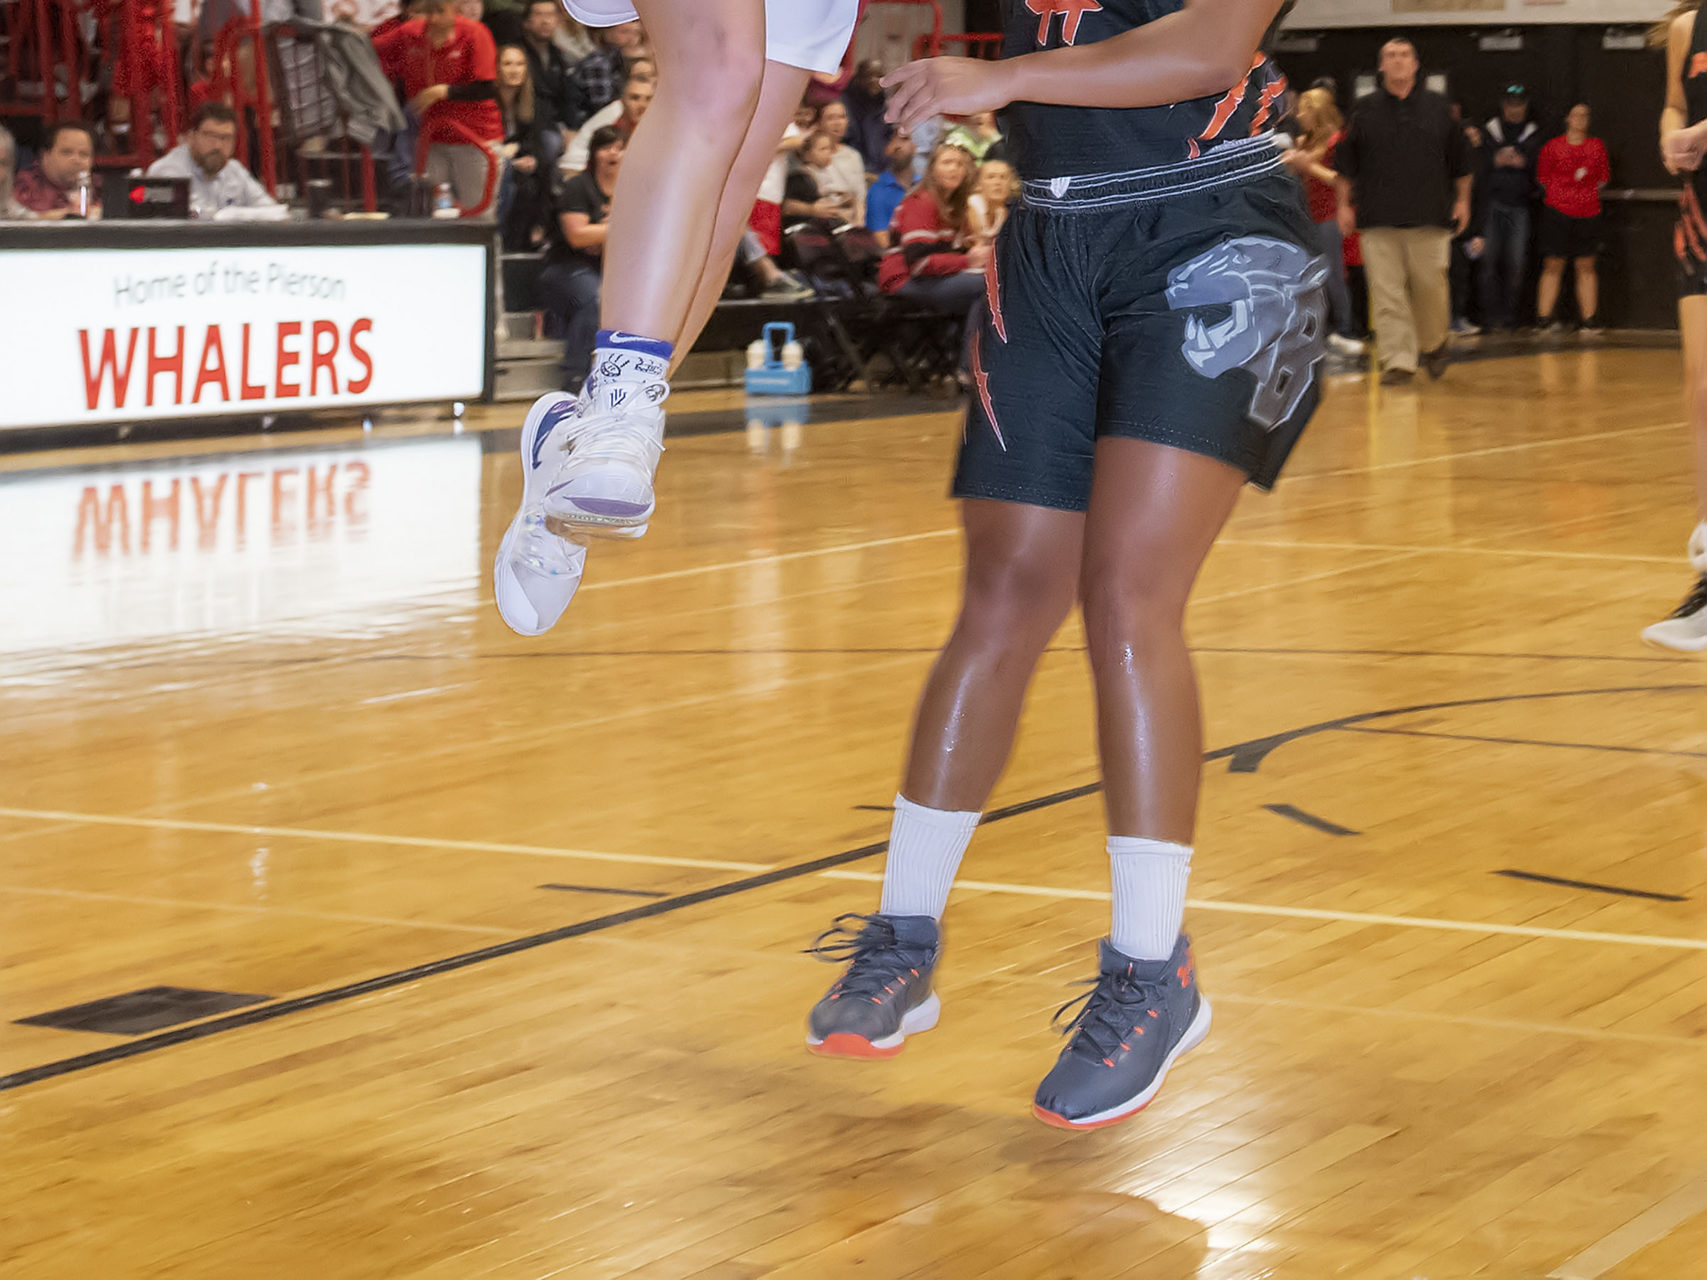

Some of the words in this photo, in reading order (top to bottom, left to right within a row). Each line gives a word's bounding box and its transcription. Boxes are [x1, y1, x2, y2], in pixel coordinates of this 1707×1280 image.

[114, 271, 186, 307] Home
[194, 261, 216, 296] of
[223, 262, 260, 295] the
[267, 262, 346, 302] Pierson
[77, 317, 375, 410] WHALERS
